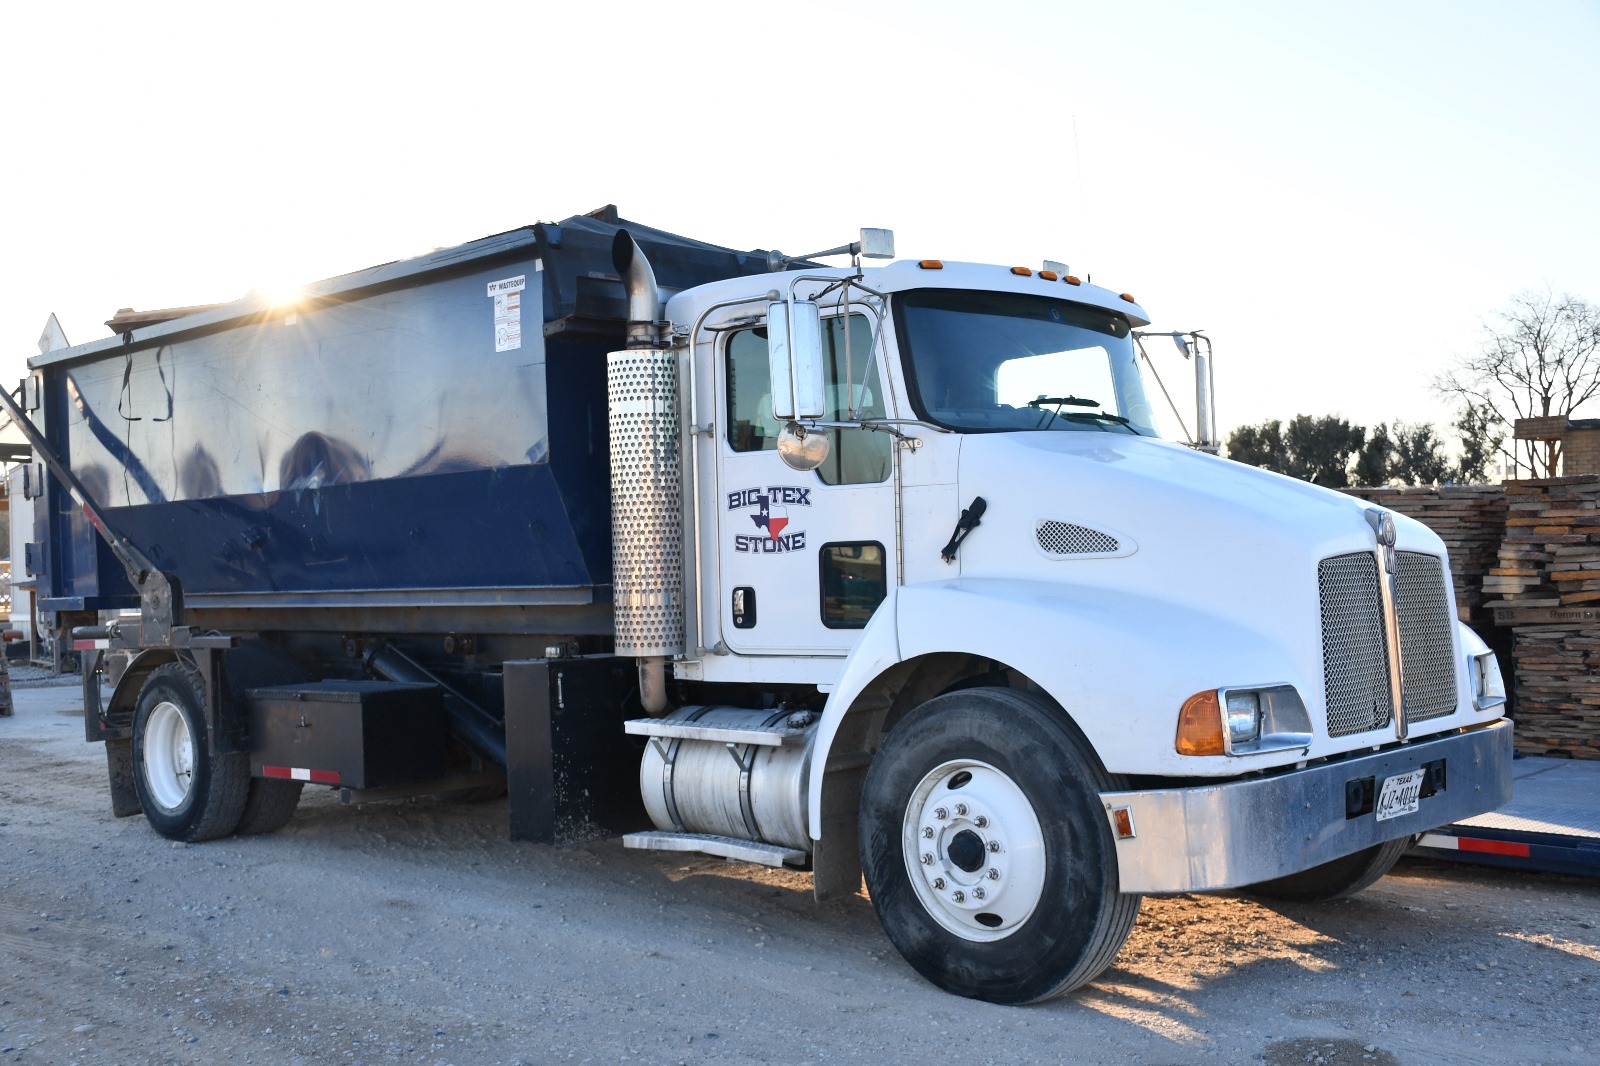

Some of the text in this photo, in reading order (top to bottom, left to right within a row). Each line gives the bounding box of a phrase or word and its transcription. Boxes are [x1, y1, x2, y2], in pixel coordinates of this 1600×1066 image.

[498, 278, 525, 290] WASTEQUIP
[727, 486, 812, 511] BIG TEX
[735, 530, 806, 554] STONE
[1396, 775, 1413, 786] TEXAS
